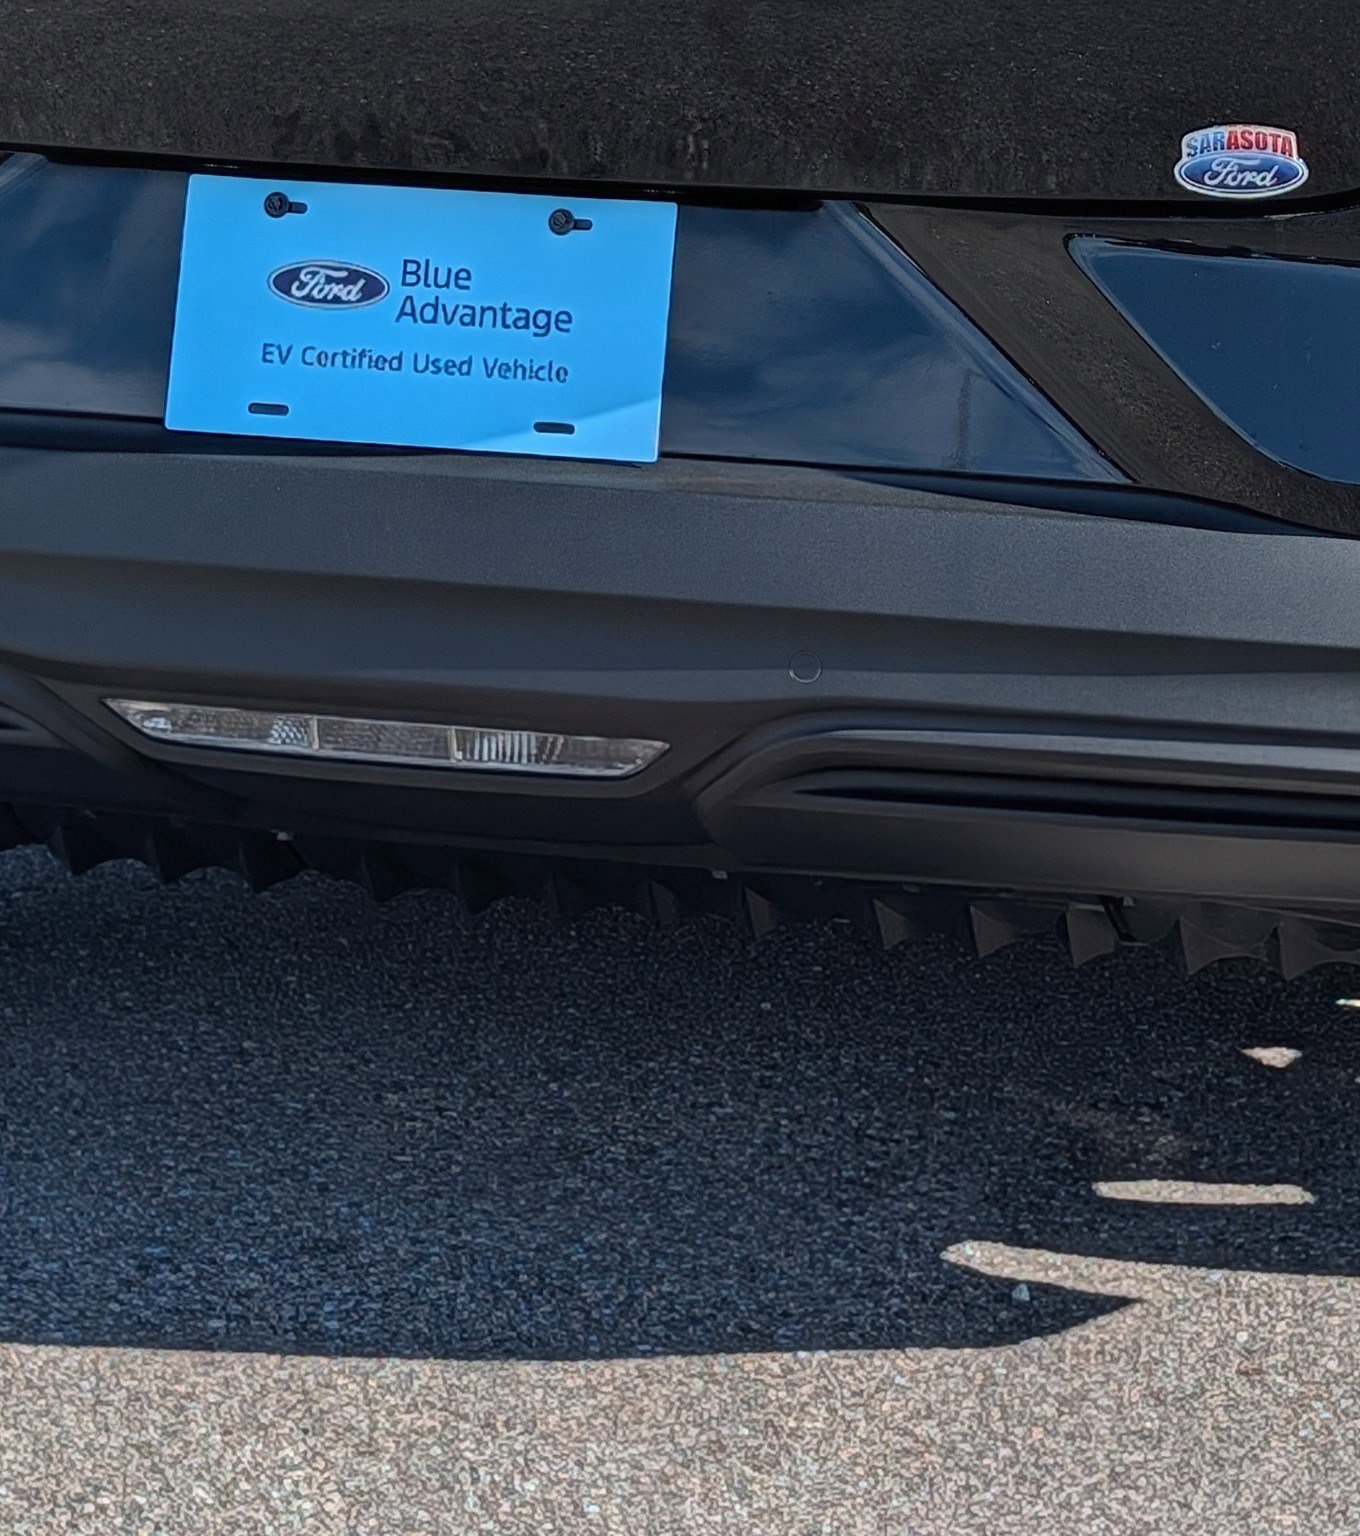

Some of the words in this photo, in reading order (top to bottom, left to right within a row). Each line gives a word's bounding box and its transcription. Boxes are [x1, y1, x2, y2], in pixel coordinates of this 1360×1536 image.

[1187, 130, 1293, 157] SARASOTA
[1203, 157, 1279, 187] Ford
[289, 267, 364, 303] Ford
[400, 258, 472, 291] Blue
[395, 295, 573, 338] Advantage
[261, 342, 293, 365] EV
[301, 346, 403, 372] Certified
[413, 353, 473, 377] Used
[483, 357, 569, 384] Vehicle
